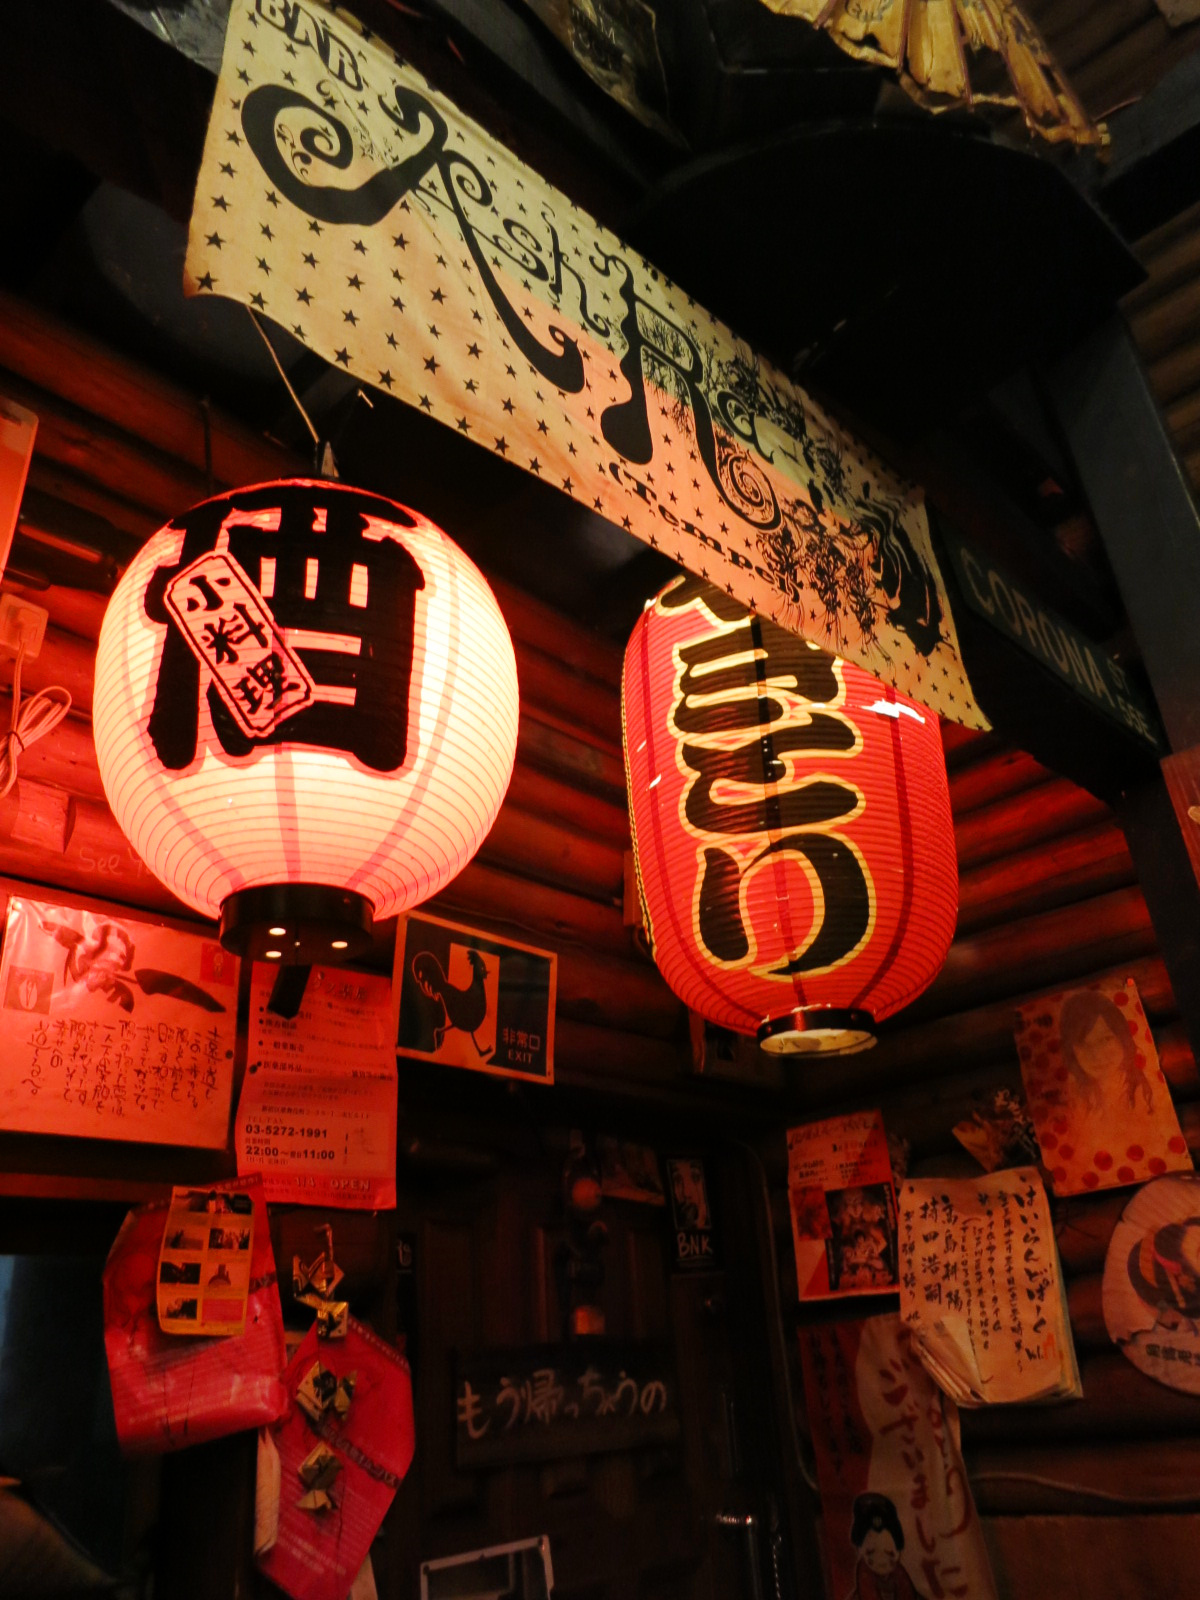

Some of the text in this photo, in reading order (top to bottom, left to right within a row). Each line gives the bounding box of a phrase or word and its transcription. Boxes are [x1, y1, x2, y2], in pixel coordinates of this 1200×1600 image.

[254, 0, 363, 92] BAR
[960, 547, 1116, 708] CORONA
[185, 573, 301, 716] 小料理
[78, 847, 124, 876] See
[502, 1025, 541, 1051] 非常口
[507, 1047, 533, 1065] EXIT
[245, 1123, 328, 1139] 03-5272-1991
[329, 1177, 371, 1191] OPEN
[676, 1231, 714, 1259] BNK
